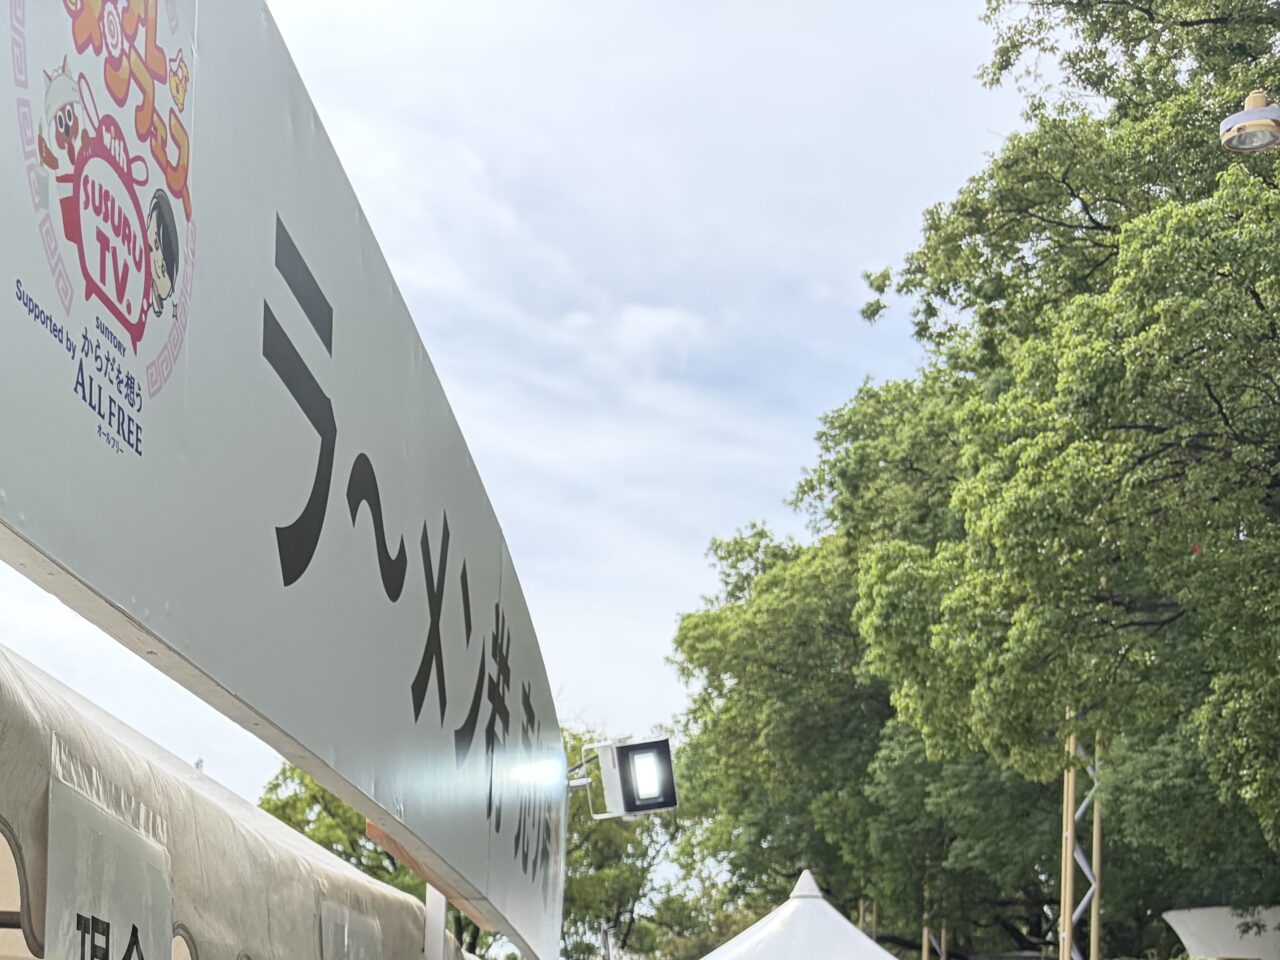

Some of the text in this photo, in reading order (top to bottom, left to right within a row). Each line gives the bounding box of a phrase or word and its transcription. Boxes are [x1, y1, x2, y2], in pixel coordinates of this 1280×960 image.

[101, 124, 128, 174] with
[82, 174, 144, 273] SUSURU
[15, 278, 77, 361] Supported by
[95, 315, 127, 359] SUNTORY
[74, 357, 143, 457] ALL FREE
[81, 326, 143, 413] からだを想う
[96, 423, 124, 454] オールフリー
